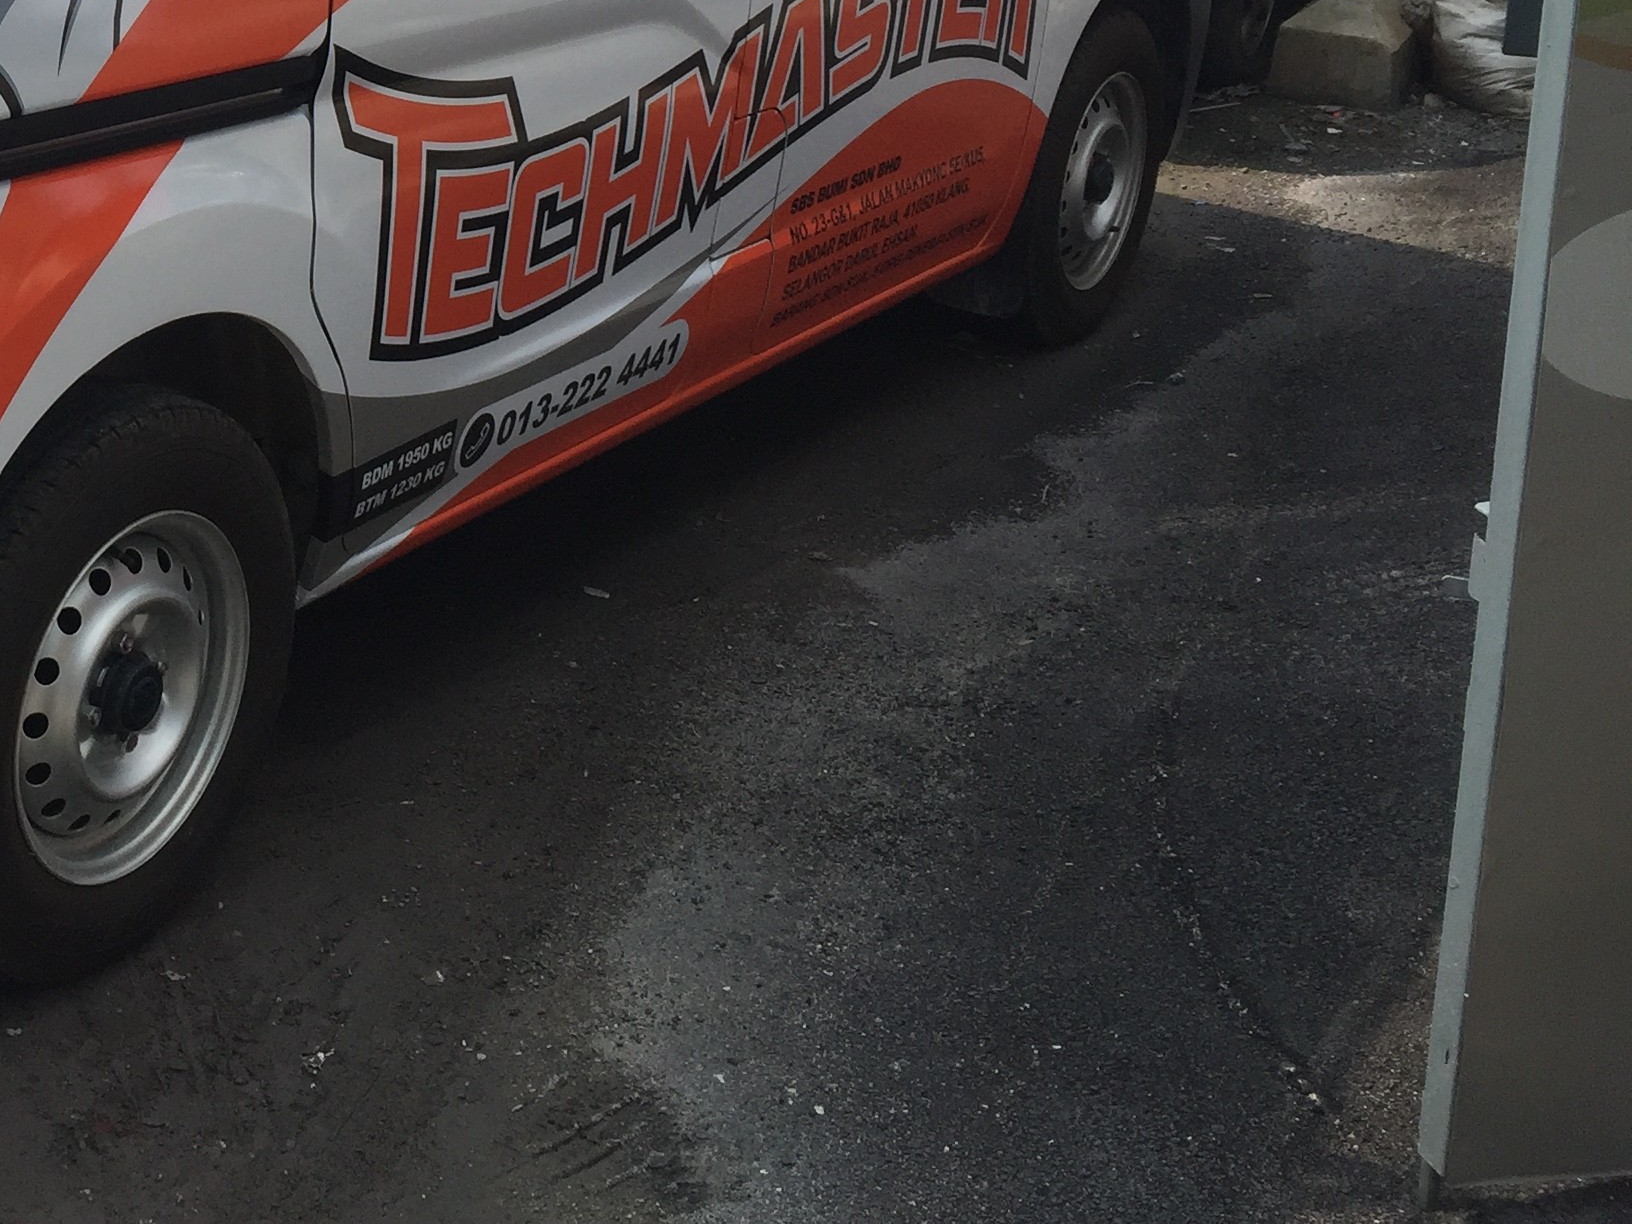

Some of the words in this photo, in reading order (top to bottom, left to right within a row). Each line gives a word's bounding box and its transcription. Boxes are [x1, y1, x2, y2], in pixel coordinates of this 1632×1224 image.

[858, 184, 894, 216] JALAN
[787, 240, 836, 274] BANDAR
[496, 364, 612, 446] 013-222
[616, 333, 683, 387] 4441
[353, 488, 388, 519] BTM
[390, 472, 423, 500] 1230
[423, 460, 446, 483] KG
[361, 459, 395, 490] BDM
[397, 442, 430, 471] 1950
[432, 431, 454, 455] KG
